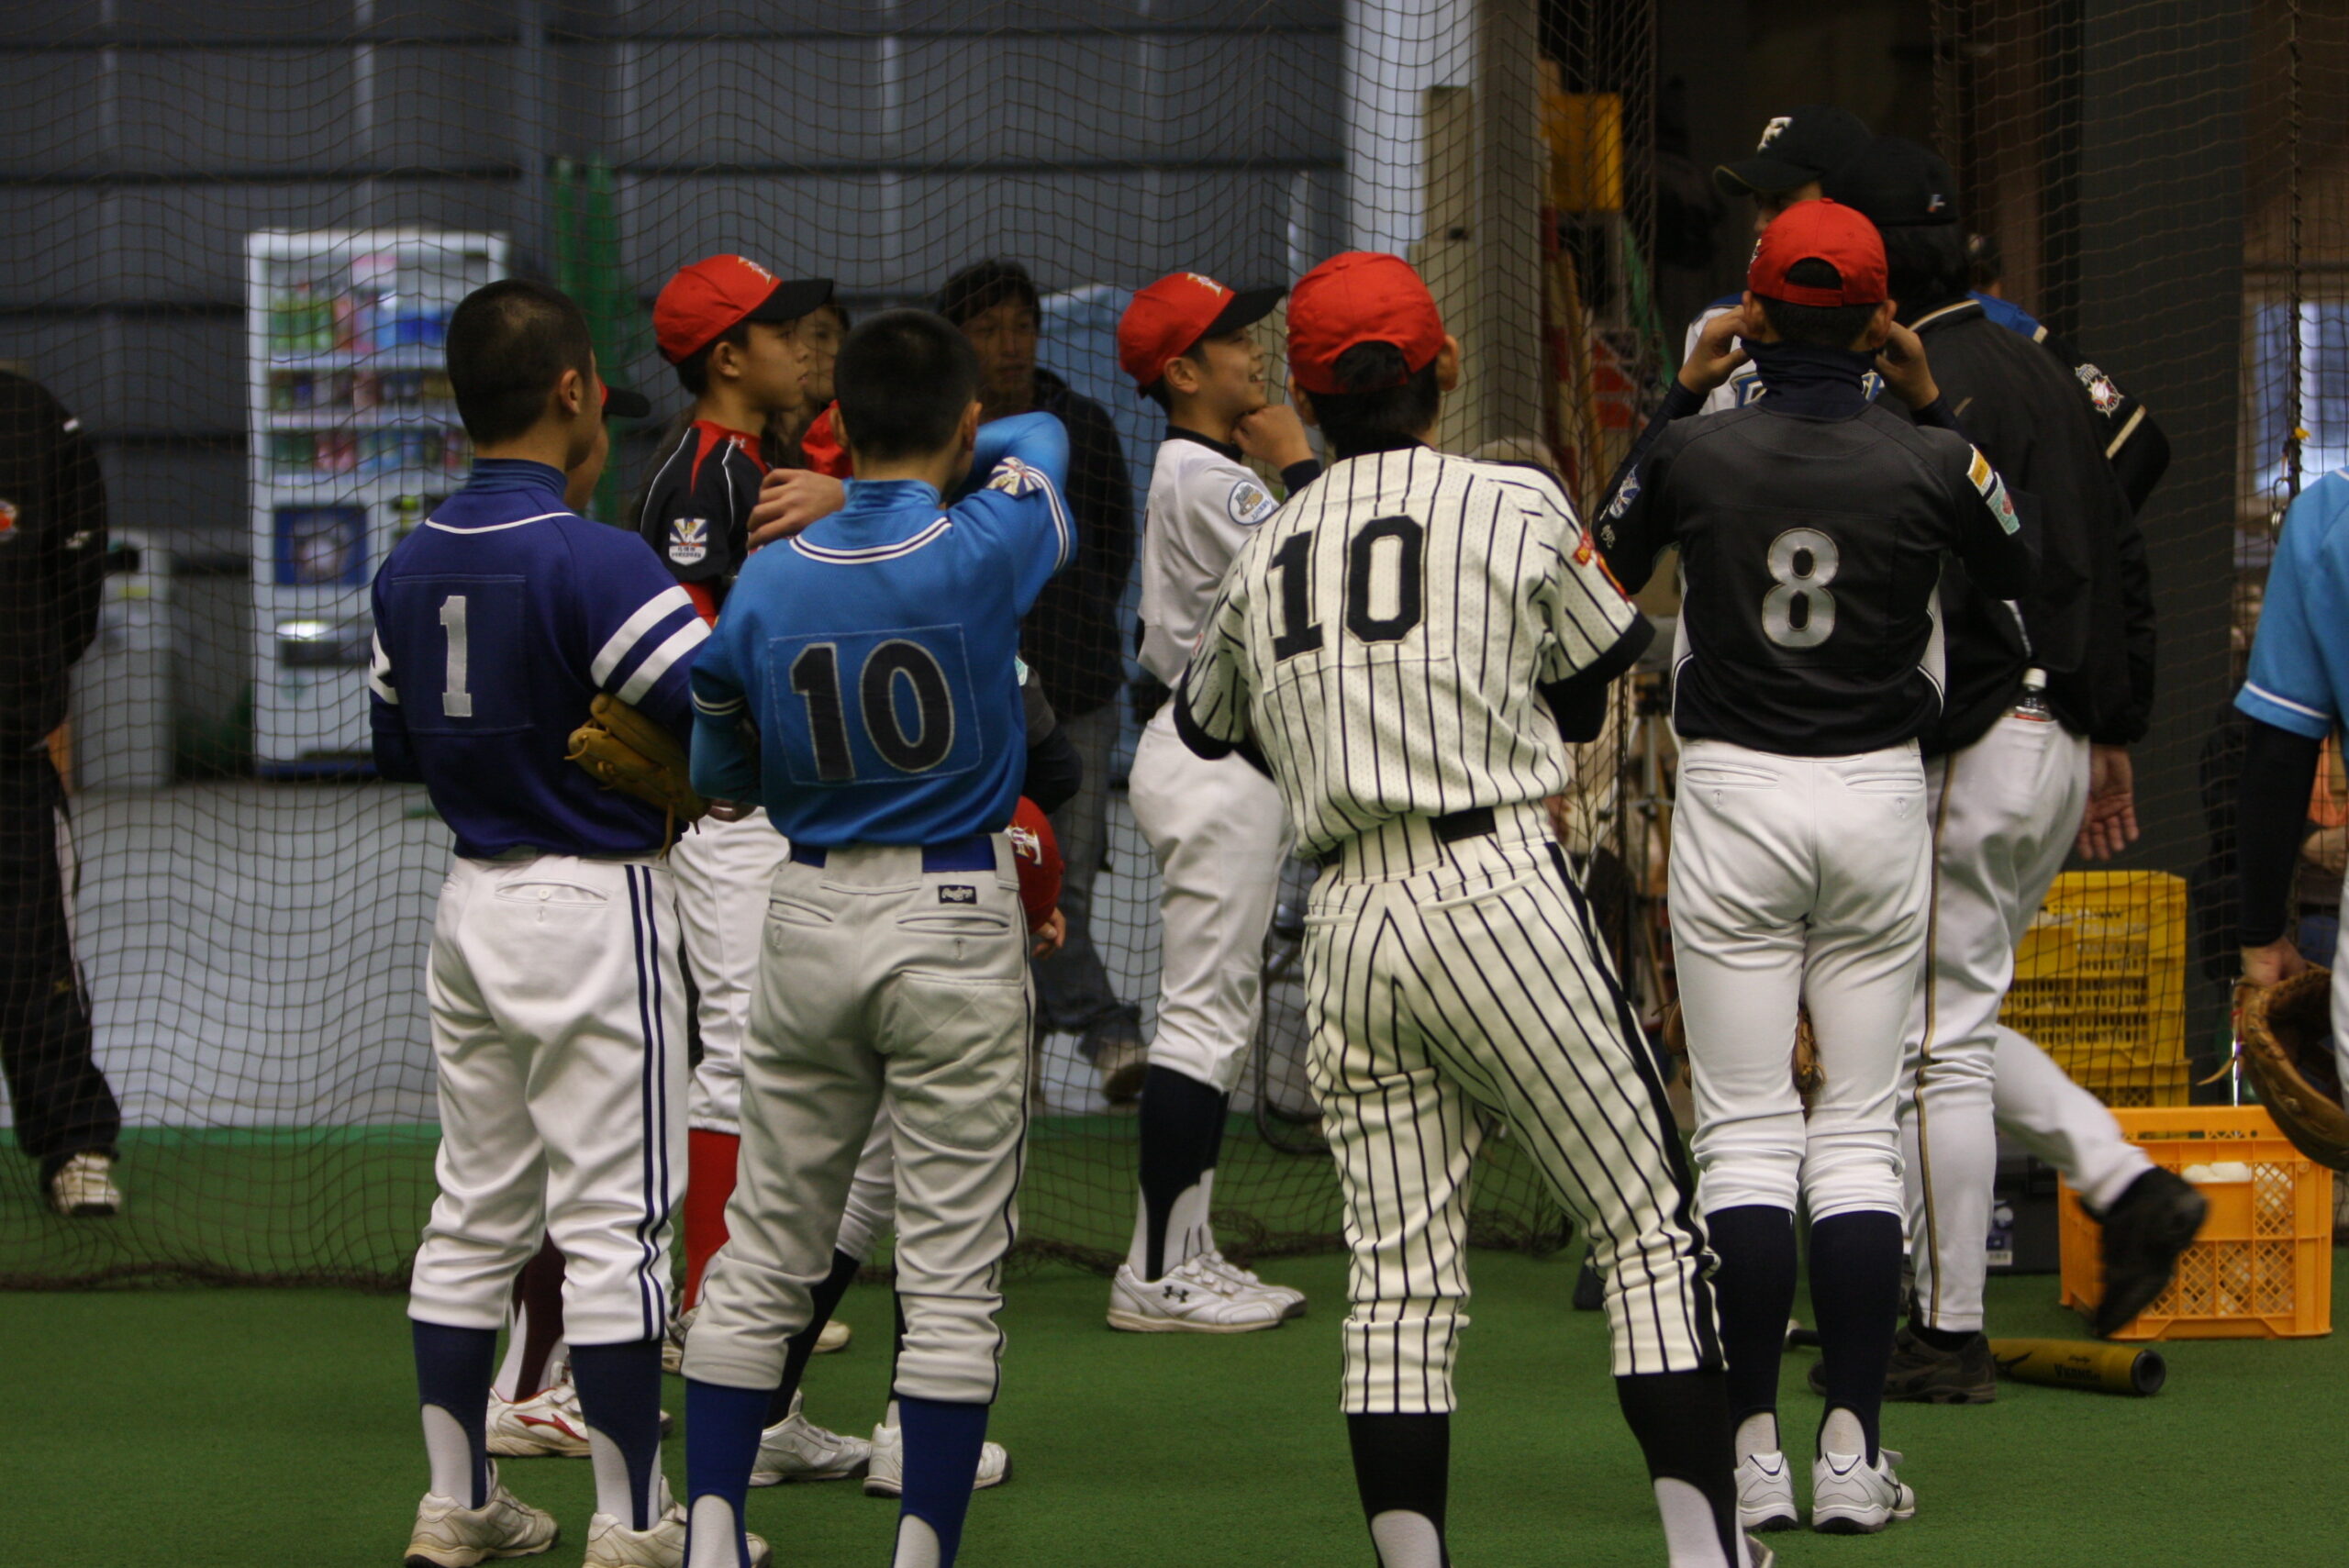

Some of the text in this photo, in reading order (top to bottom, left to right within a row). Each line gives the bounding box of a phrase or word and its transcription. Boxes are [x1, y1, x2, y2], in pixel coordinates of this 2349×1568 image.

[1268, 514, 1425, 667] 10
[1761, 527, 1839, 649] 8
[439, 595, 473, 717] 1
[788, 638, 956, 783] 10
